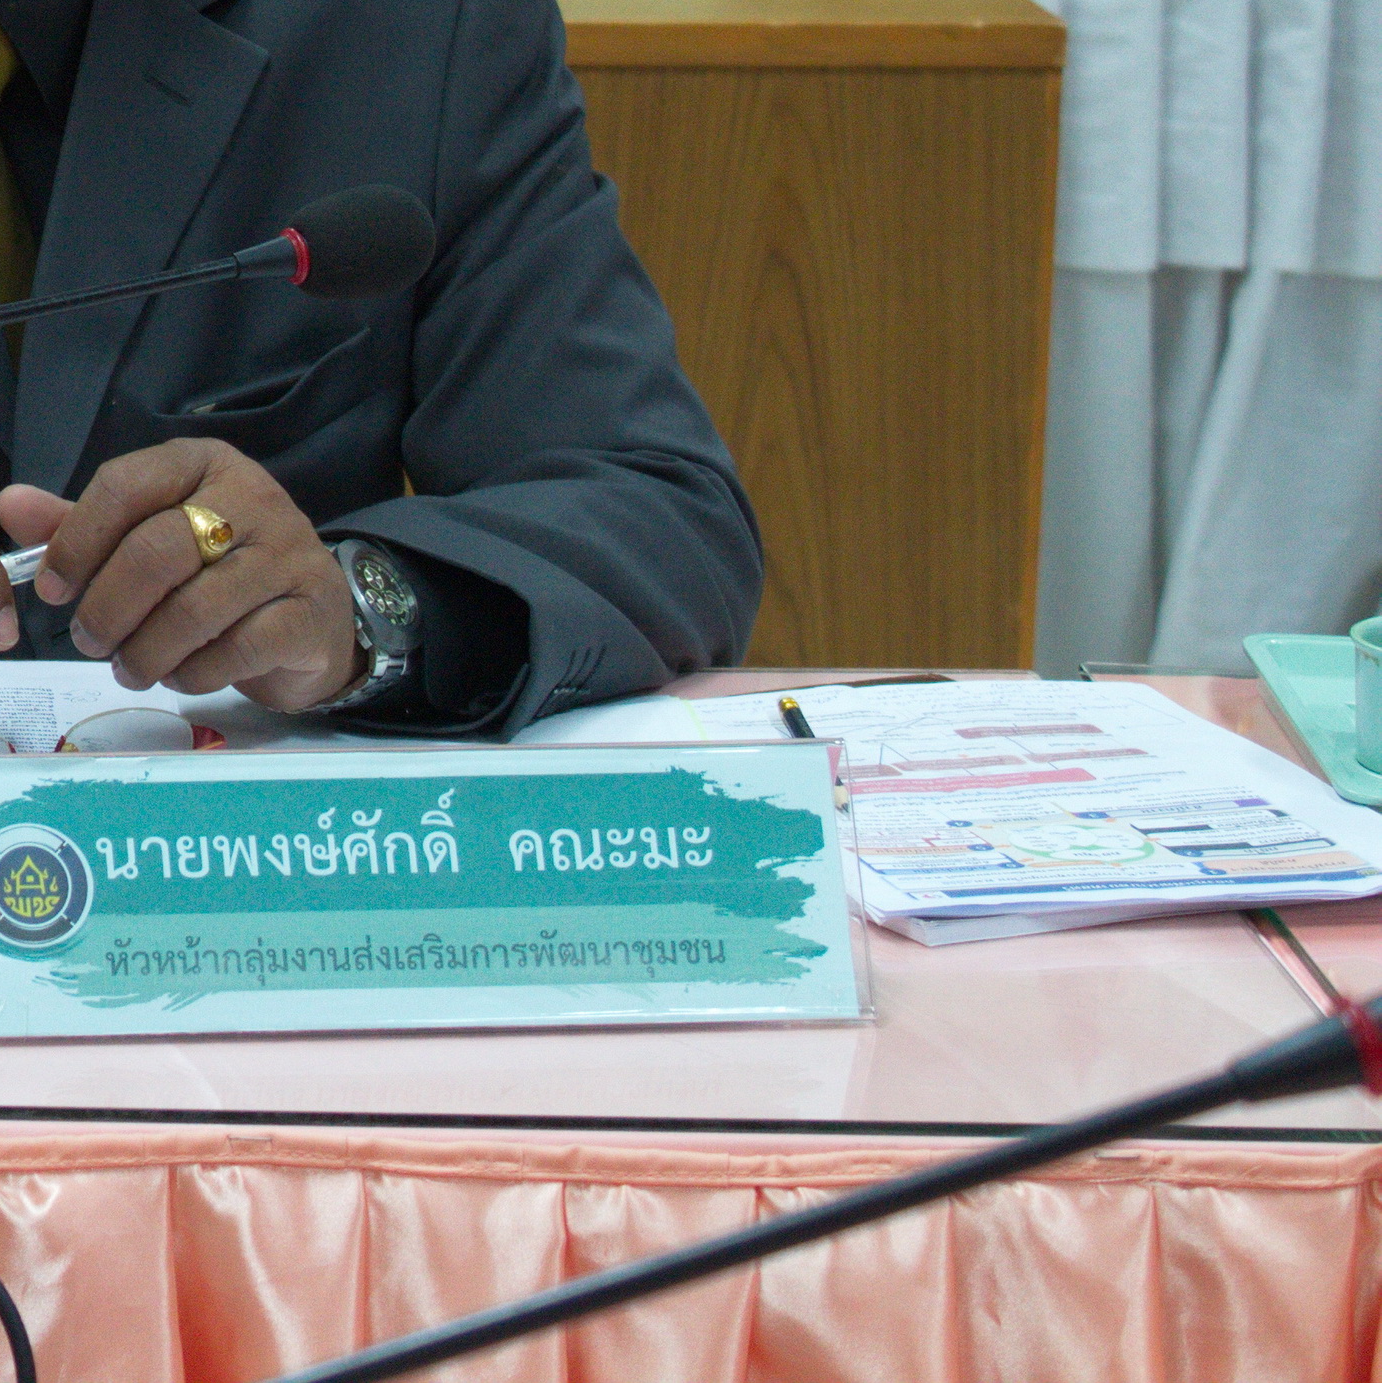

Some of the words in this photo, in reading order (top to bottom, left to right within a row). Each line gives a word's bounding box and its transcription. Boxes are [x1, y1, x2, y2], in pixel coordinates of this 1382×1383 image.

[96, 787, 459, 880] นายพงษ์ศักดิ์
[509, 819, 713, 872] คณะมะ
[106, 929, 726, 987] หัวหน้ากลุ่มงานส่งเสริมการพัฒนาชุมชน
